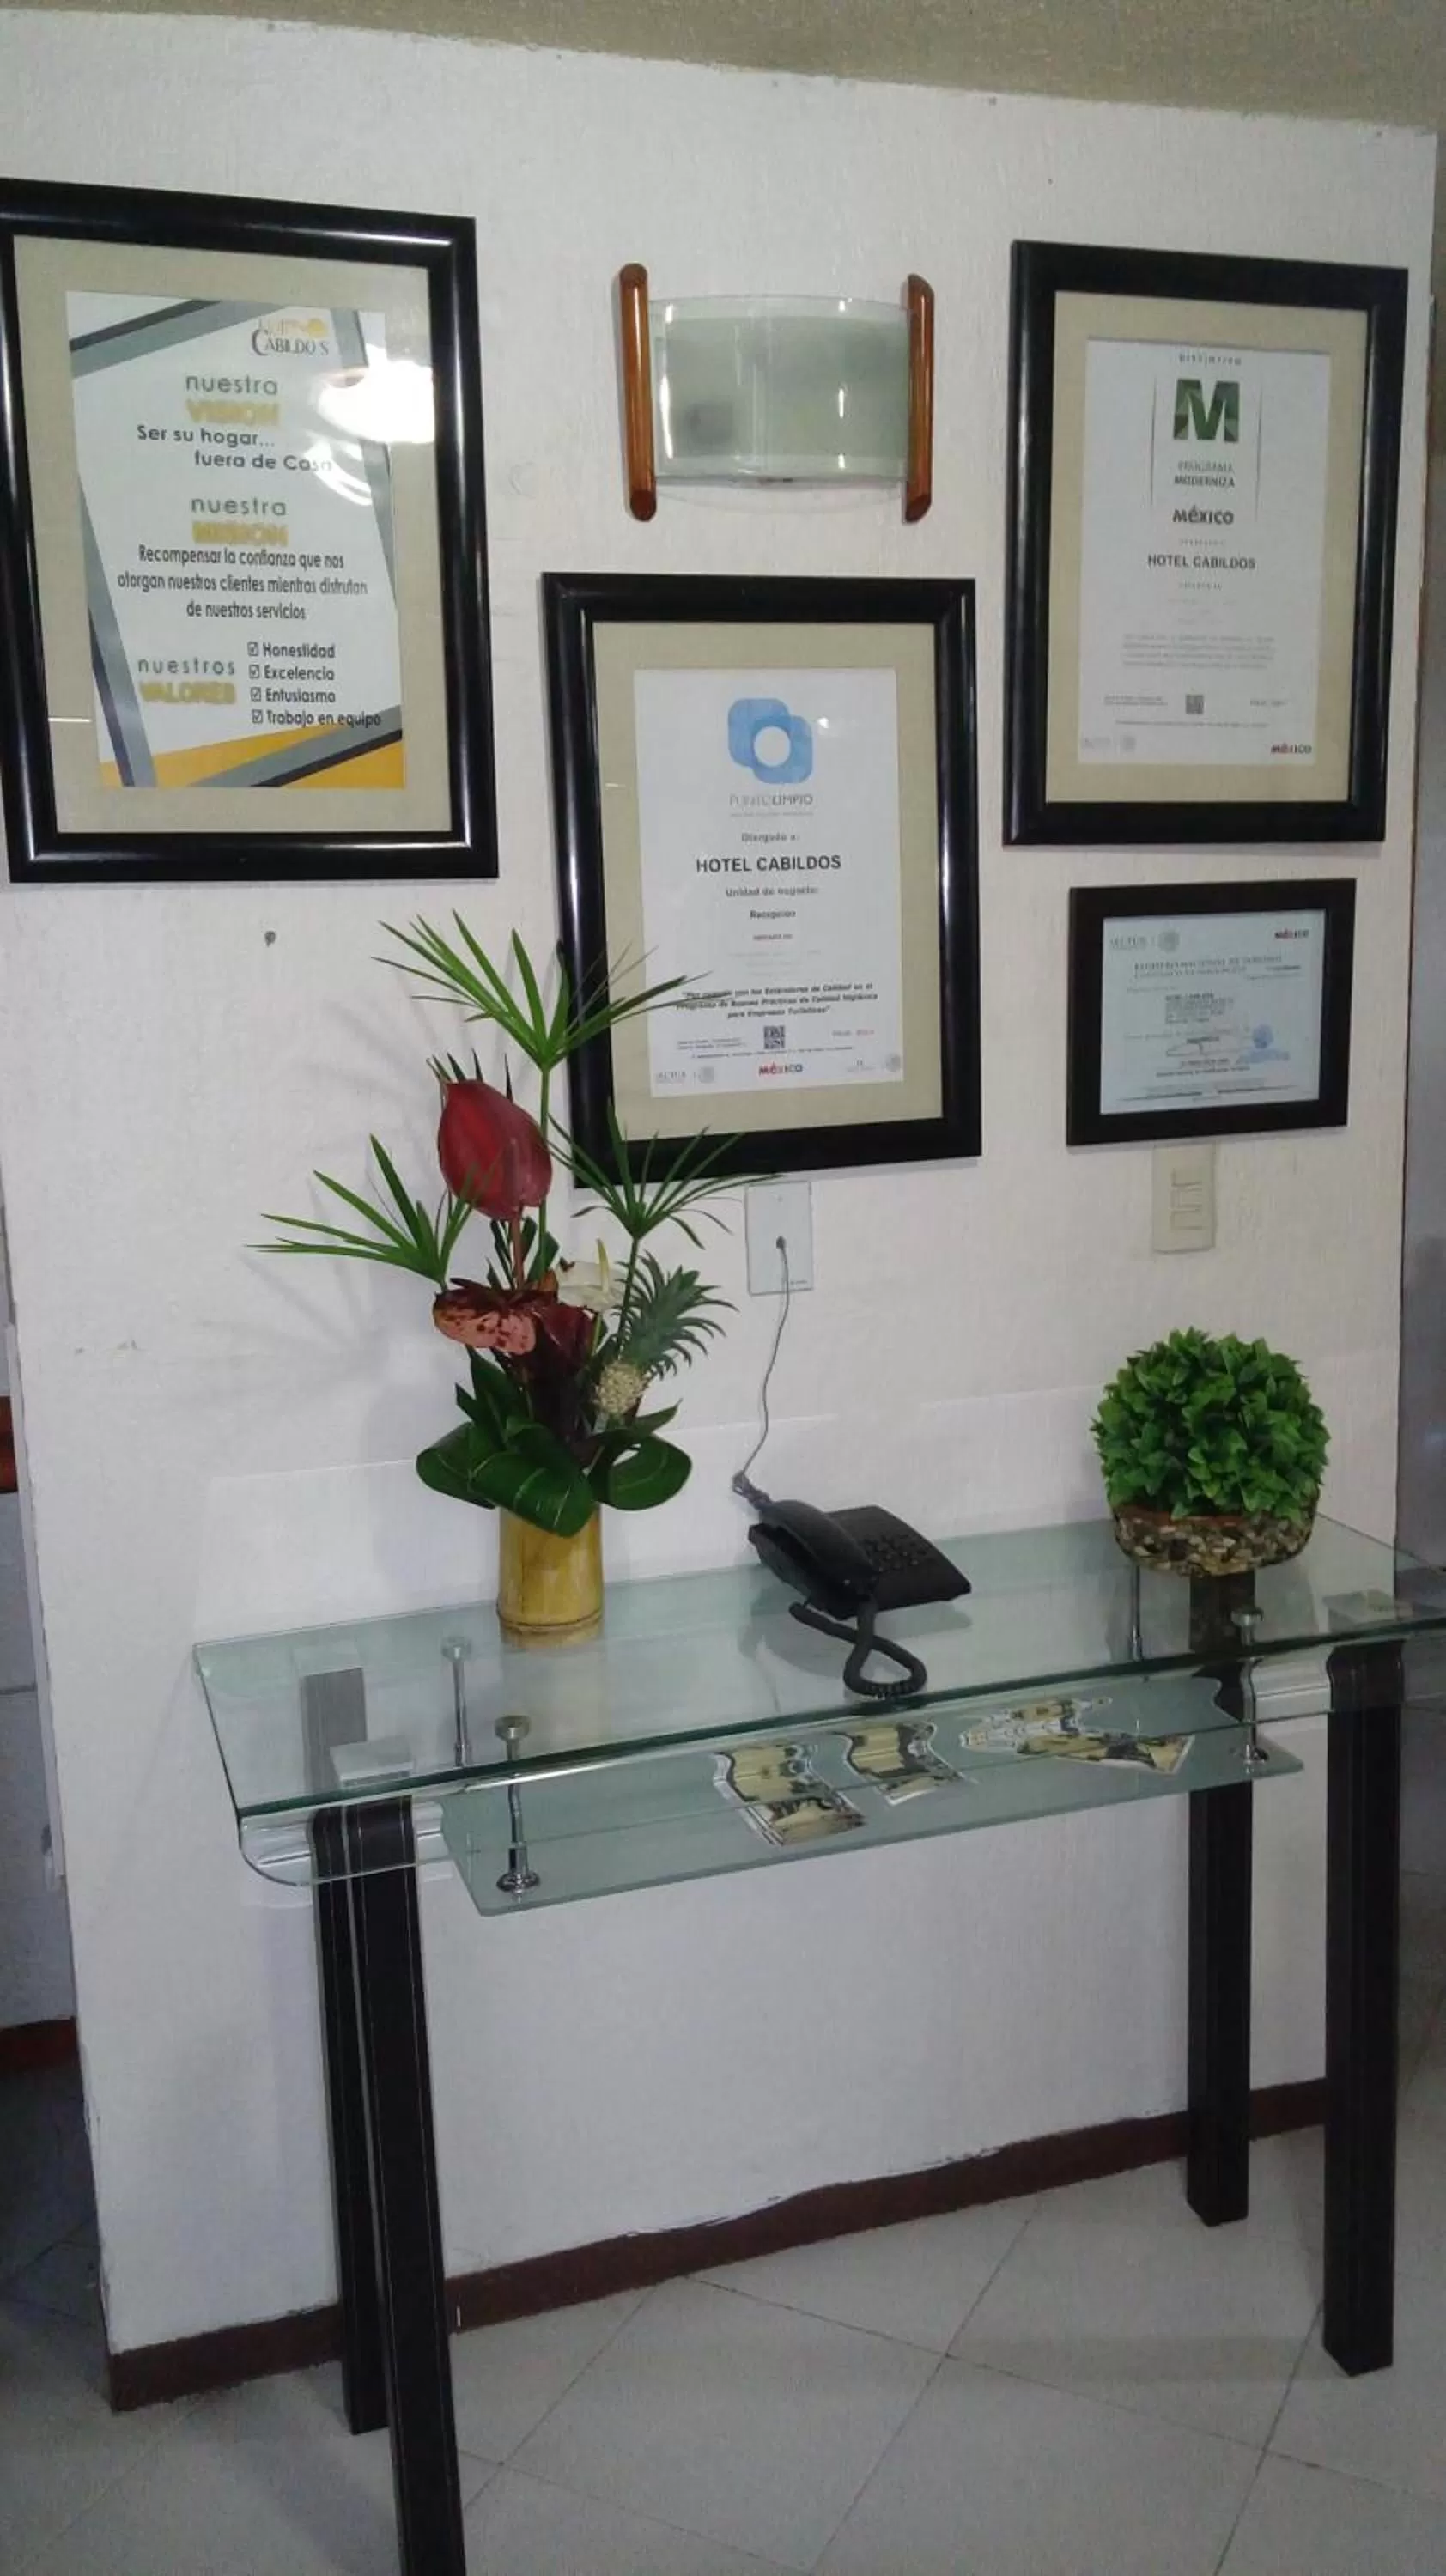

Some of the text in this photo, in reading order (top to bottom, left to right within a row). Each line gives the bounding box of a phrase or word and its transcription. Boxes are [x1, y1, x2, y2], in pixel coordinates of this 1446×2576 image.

[185, 374, 278, 395] nuestra
[1173, 379, 1240, 443] M
[137, 425, 275, 448] Ser su hogar...
[195, 450, 245, 468] fuera
[252, 453, 276, 469] de
[1174, 476, 1235, 488] MODERNIZA
[191, 496, 286, 516] nuestra
[1172, 505, 1234, 525] MÉXICO
[138, 545, 344, 571] Recompensar la confianza que nos
[1147, 554, 1256, 570] HOTEL CABILDOS
[118, 571, 368, 595] otorgan nuestros clientes mientras disfrutan
[186, 599, 306, 620] de nuestros servicios
[263, 643, 336, 659] Honestidad
[138, 658, 234, 676] nuestros
[264, 665, 335, 681] Excelencia
[265, 688, 336, 703] Entusiasmo
[267, 710, 381, 728] Trabajo en equipo
[696, 855, 841, 872] HOTEL CABILDOS
[726, 887, 760, 897] Unidad
